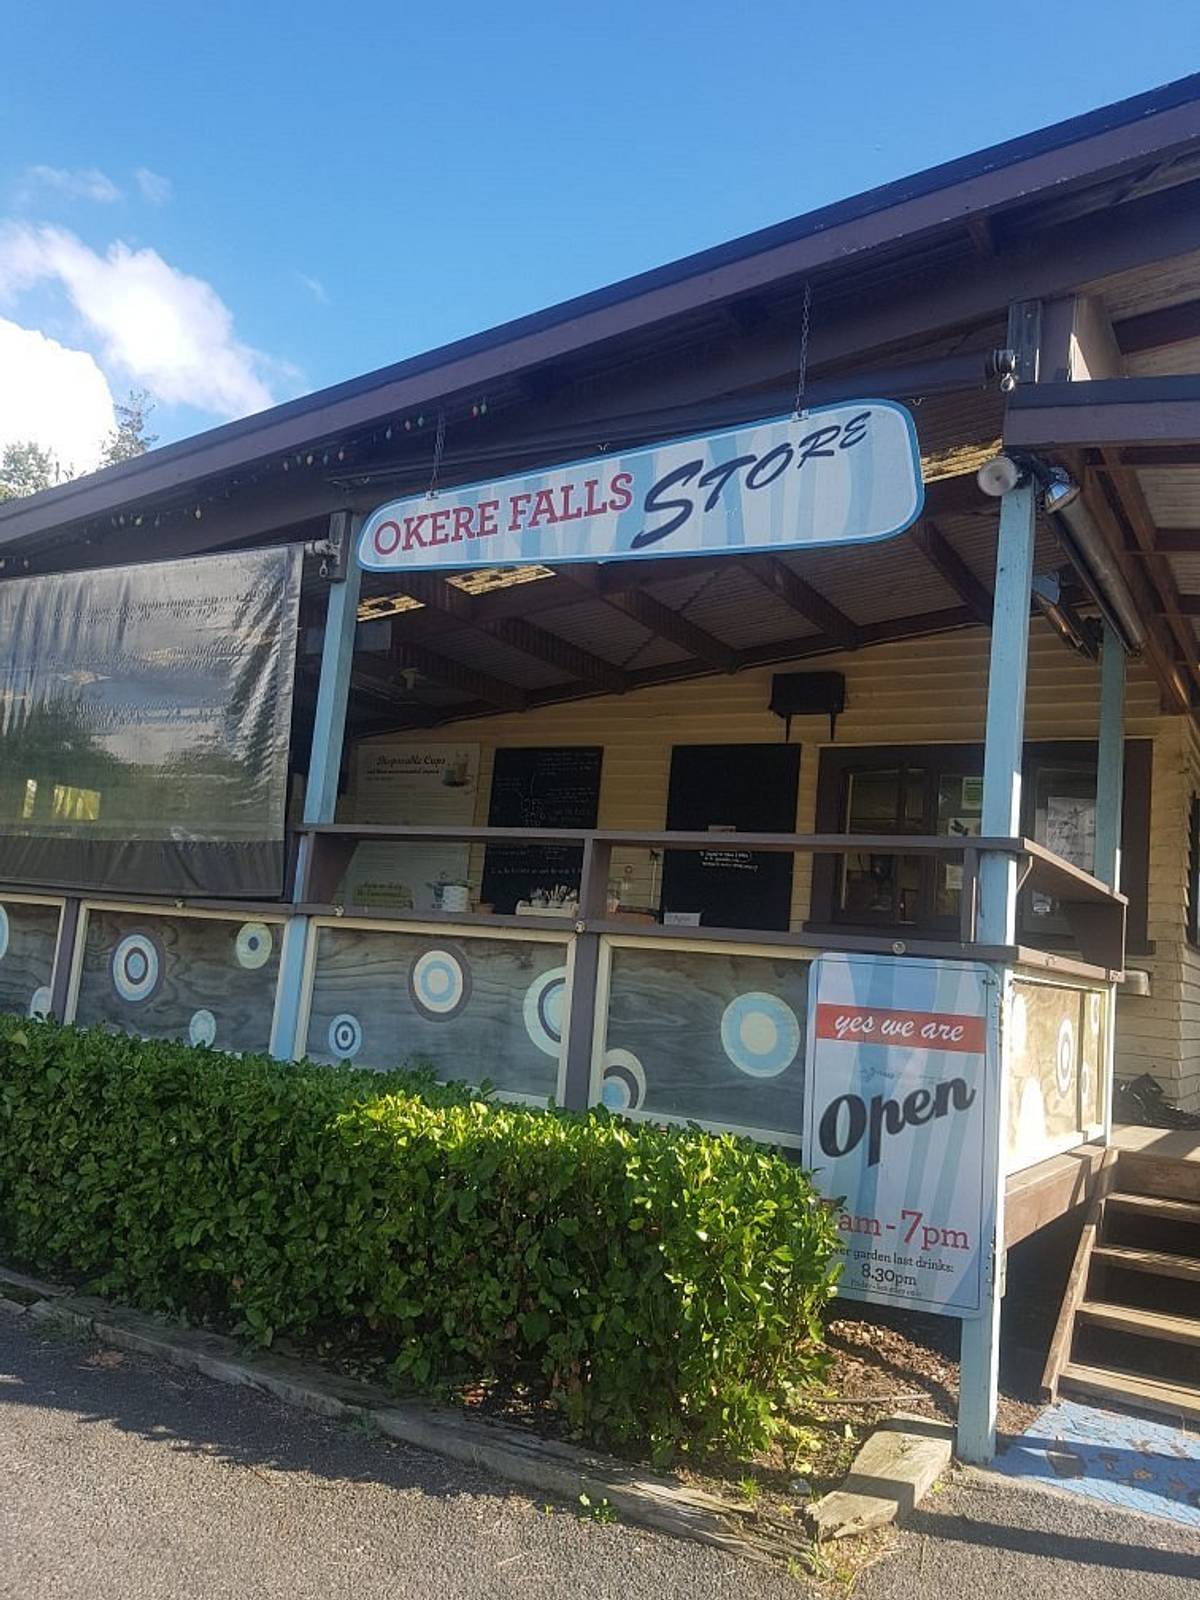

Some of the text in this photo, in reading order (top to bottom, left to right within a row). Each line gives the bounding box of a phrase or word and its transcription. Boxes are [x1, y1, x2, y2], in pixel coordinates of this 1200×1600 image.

[374, 411, 871, 556] OKERE FALLS STORE
[834, 1013, 965, 1043] yes we are
[818, 1076, 976, 1168] Open
[854, 1249, 892, 1263] garden
[893, 1252, 913, 1266] last
[916, 1256, 954, 1272] drinks:
[861, 1263, 917, 1287] 8.30pm
